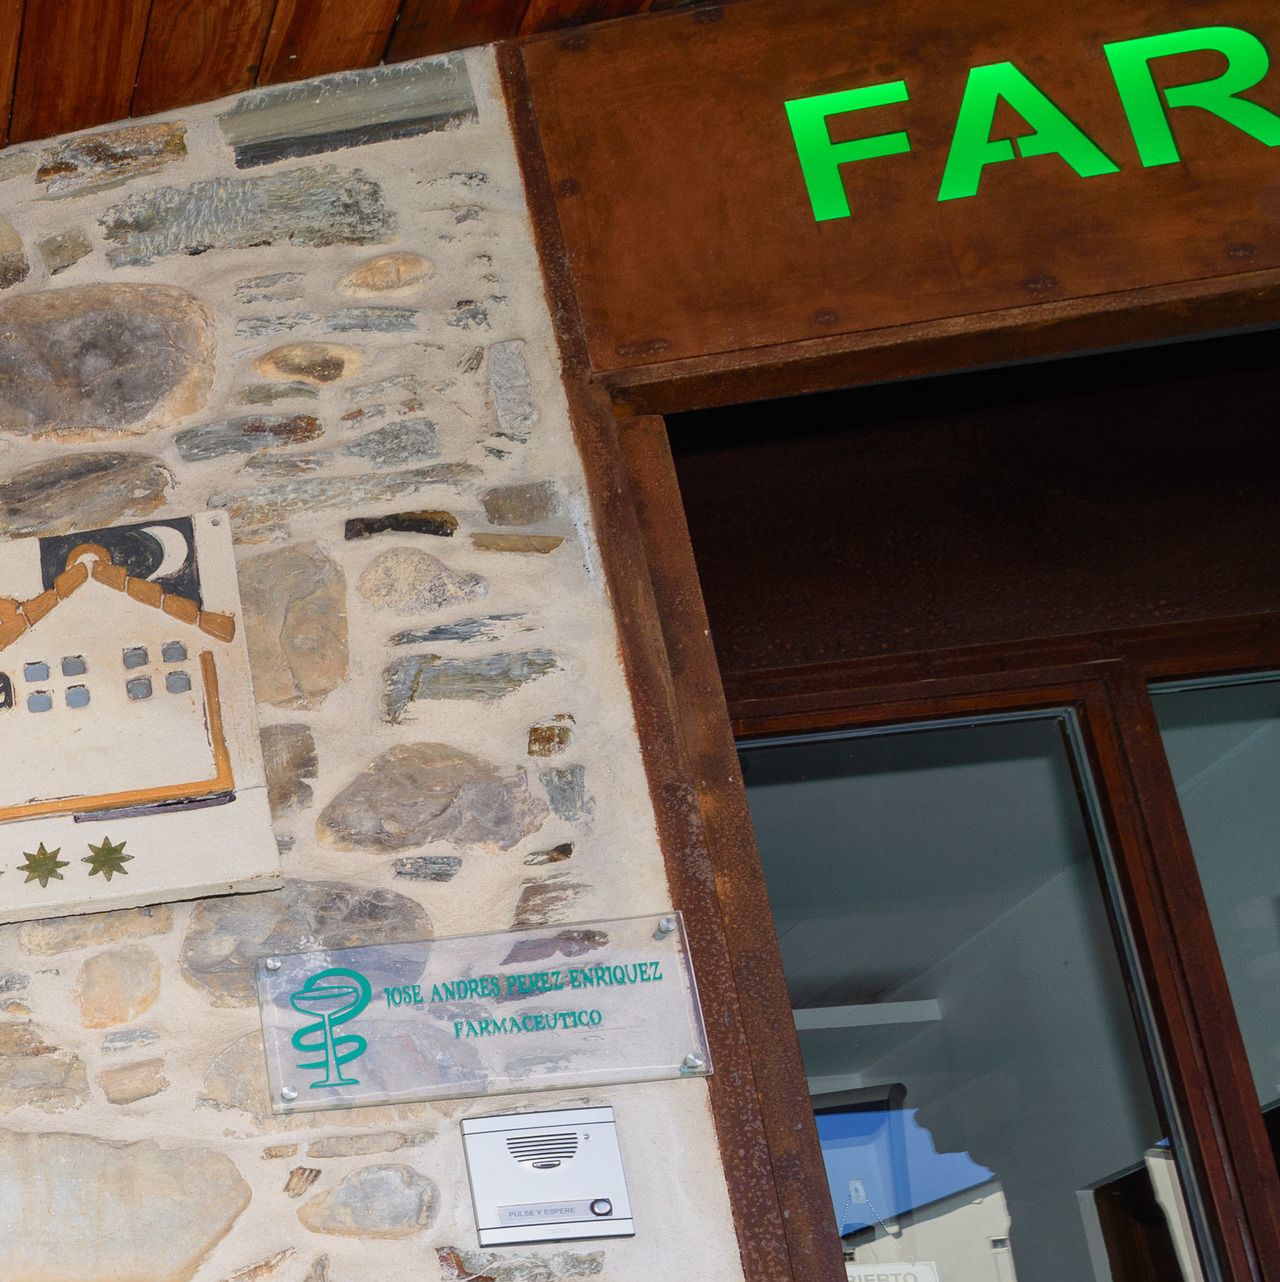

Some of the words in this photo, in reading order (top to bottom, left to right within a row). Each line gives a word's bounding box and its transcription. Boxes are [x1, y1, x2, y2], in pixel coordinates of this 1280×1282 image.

[784, 26, 1280, 221] FAR
[384, 984, 423, 1008] JOSE
[430, 976, 501, 1003] ANDRES
[506, 970, 564, 995] PEREZ
[570, 961, 662, 989] ENRIQUEZ
[453, 1009, 602, 1039] FARMACEUTICO
[508, 1210, 533, 1218] PULSE
[544, 1207, 576, 1216] ESPERE
